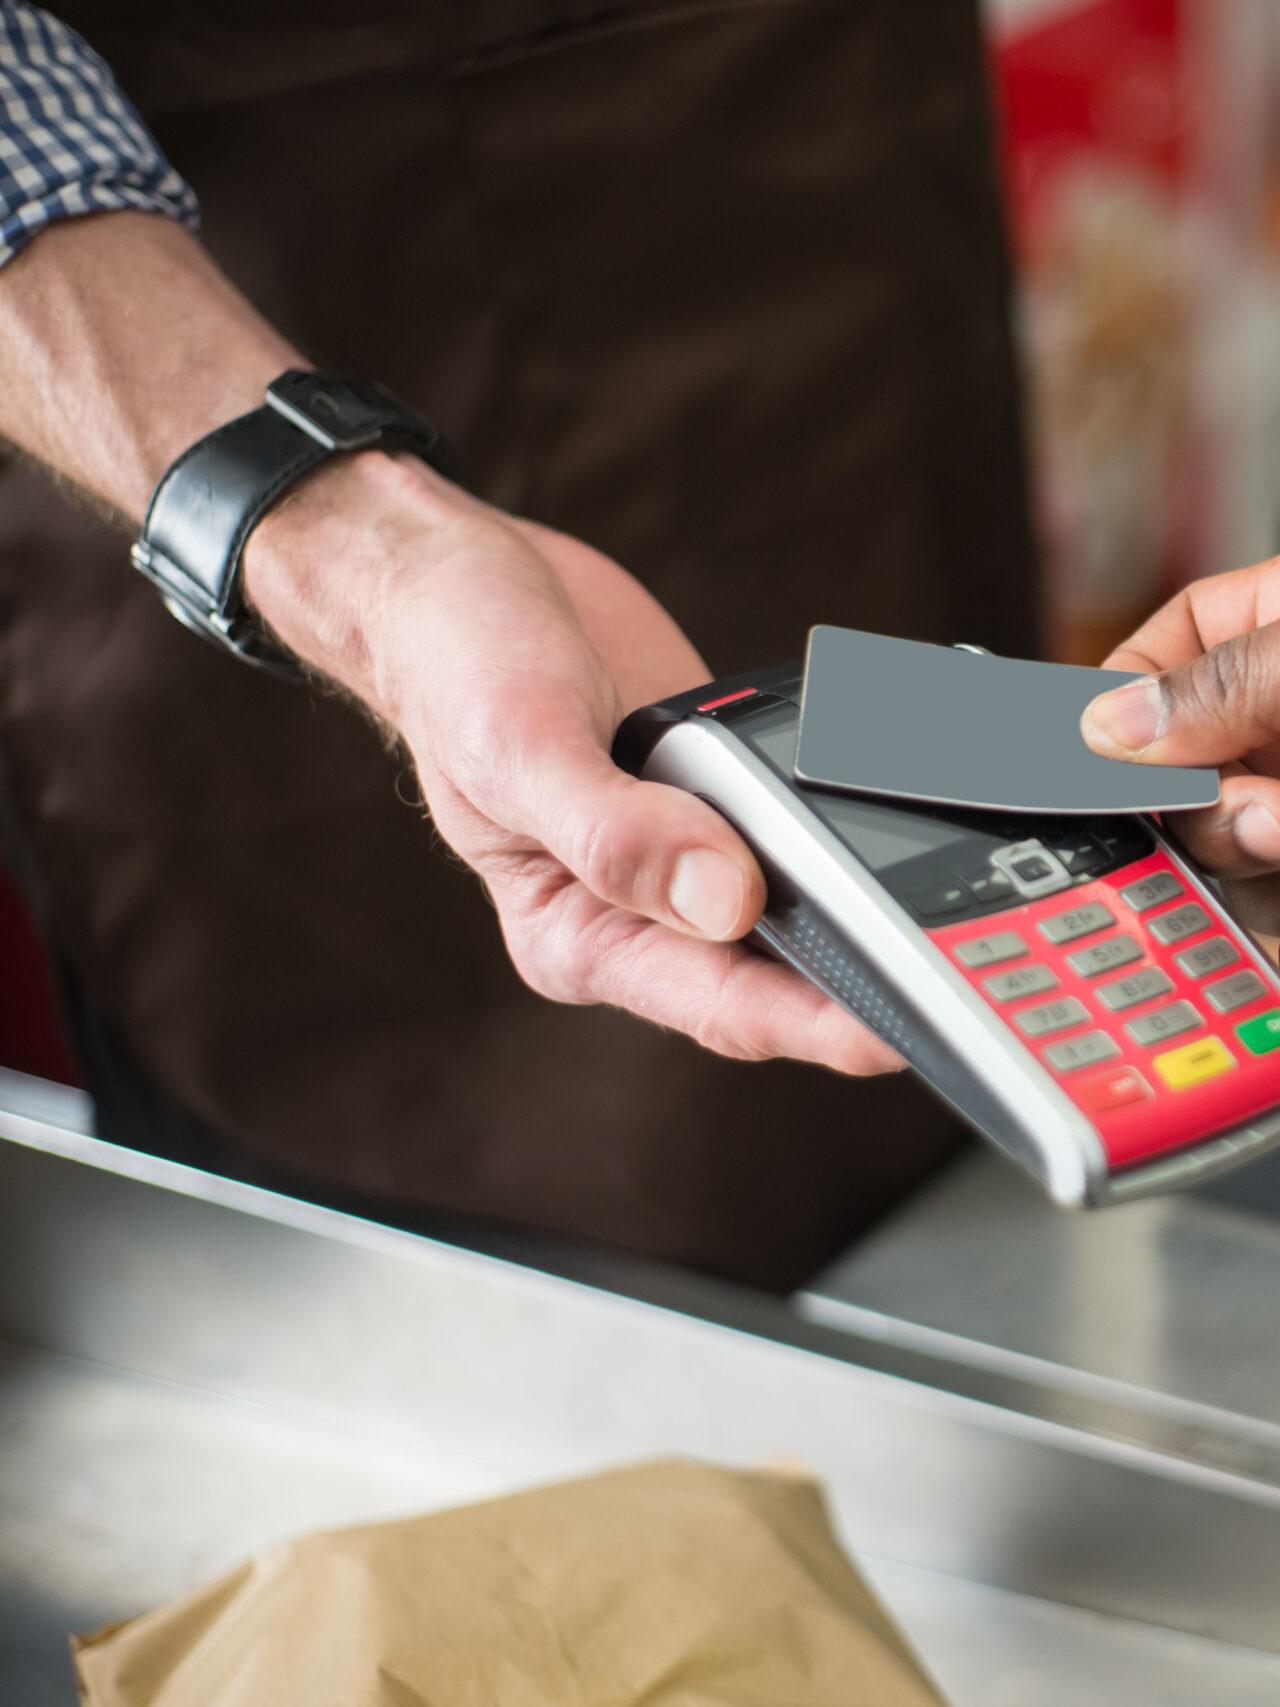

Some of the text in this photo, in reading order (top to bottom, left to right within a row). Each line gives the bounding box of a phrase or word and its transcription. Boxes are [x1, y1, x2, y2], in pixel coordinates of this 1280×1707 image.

[1138, 884, 1156, 900] 3
[1063, 914, 1078, 930] 2
[1166, 917, 1182, 932] 6
[1092, 948, 1109, 962] 5
[1194, 951, 1210, 966] 9
[1007, 975, 1022, 989] 4
[1032, 1010, 1049, 1026] 7
